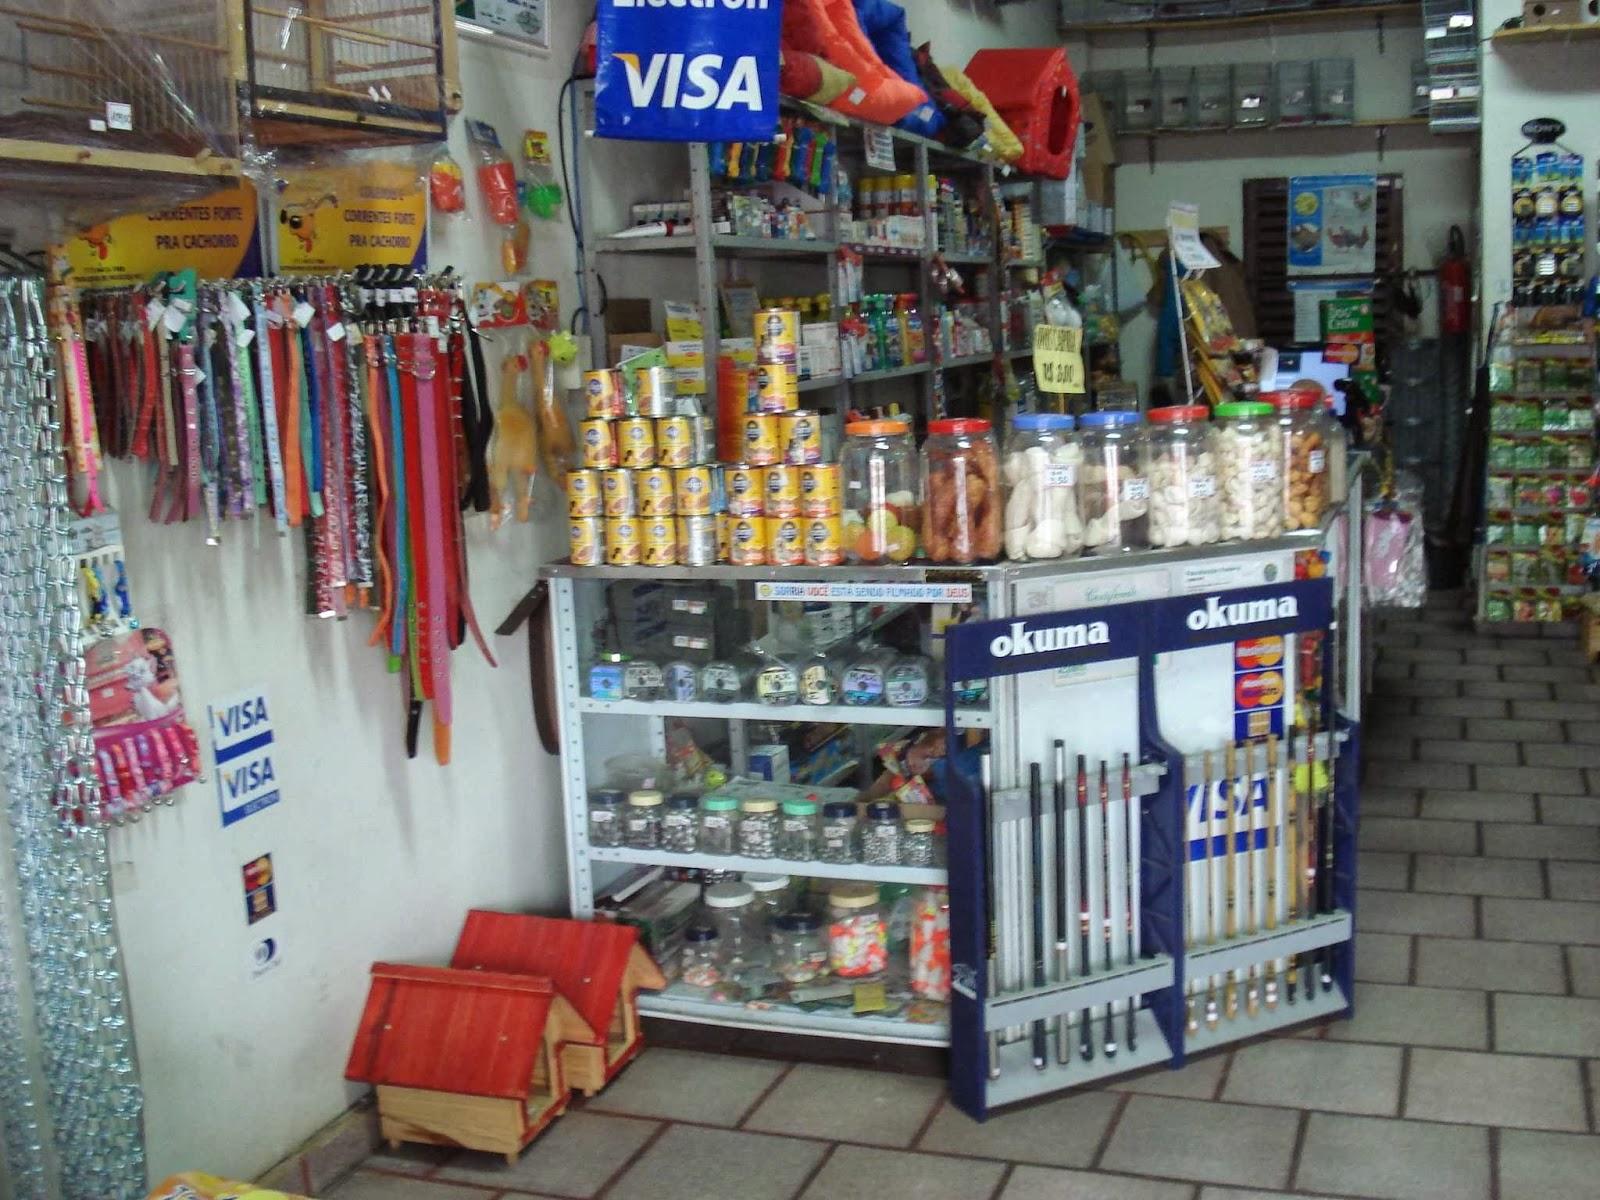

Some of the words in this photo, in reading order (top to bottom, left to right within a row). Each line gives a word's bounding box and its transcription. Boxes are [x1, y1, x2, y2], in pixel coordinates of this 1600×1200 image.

[612, 53, 763, 112] VISA
[155, 235, 181, 249] PRA
[183, 234, 239, 249] CACHORRO
[349, 234, 367, 248] PRA
[370, 234, 411, 249] CACHORRO
[1186, 596, 1299, 631] okuma
[990, 621, 1110, 658] okuma
[214, 696, 268, 736] VISA
[223, 757, 275, 798] VISA
